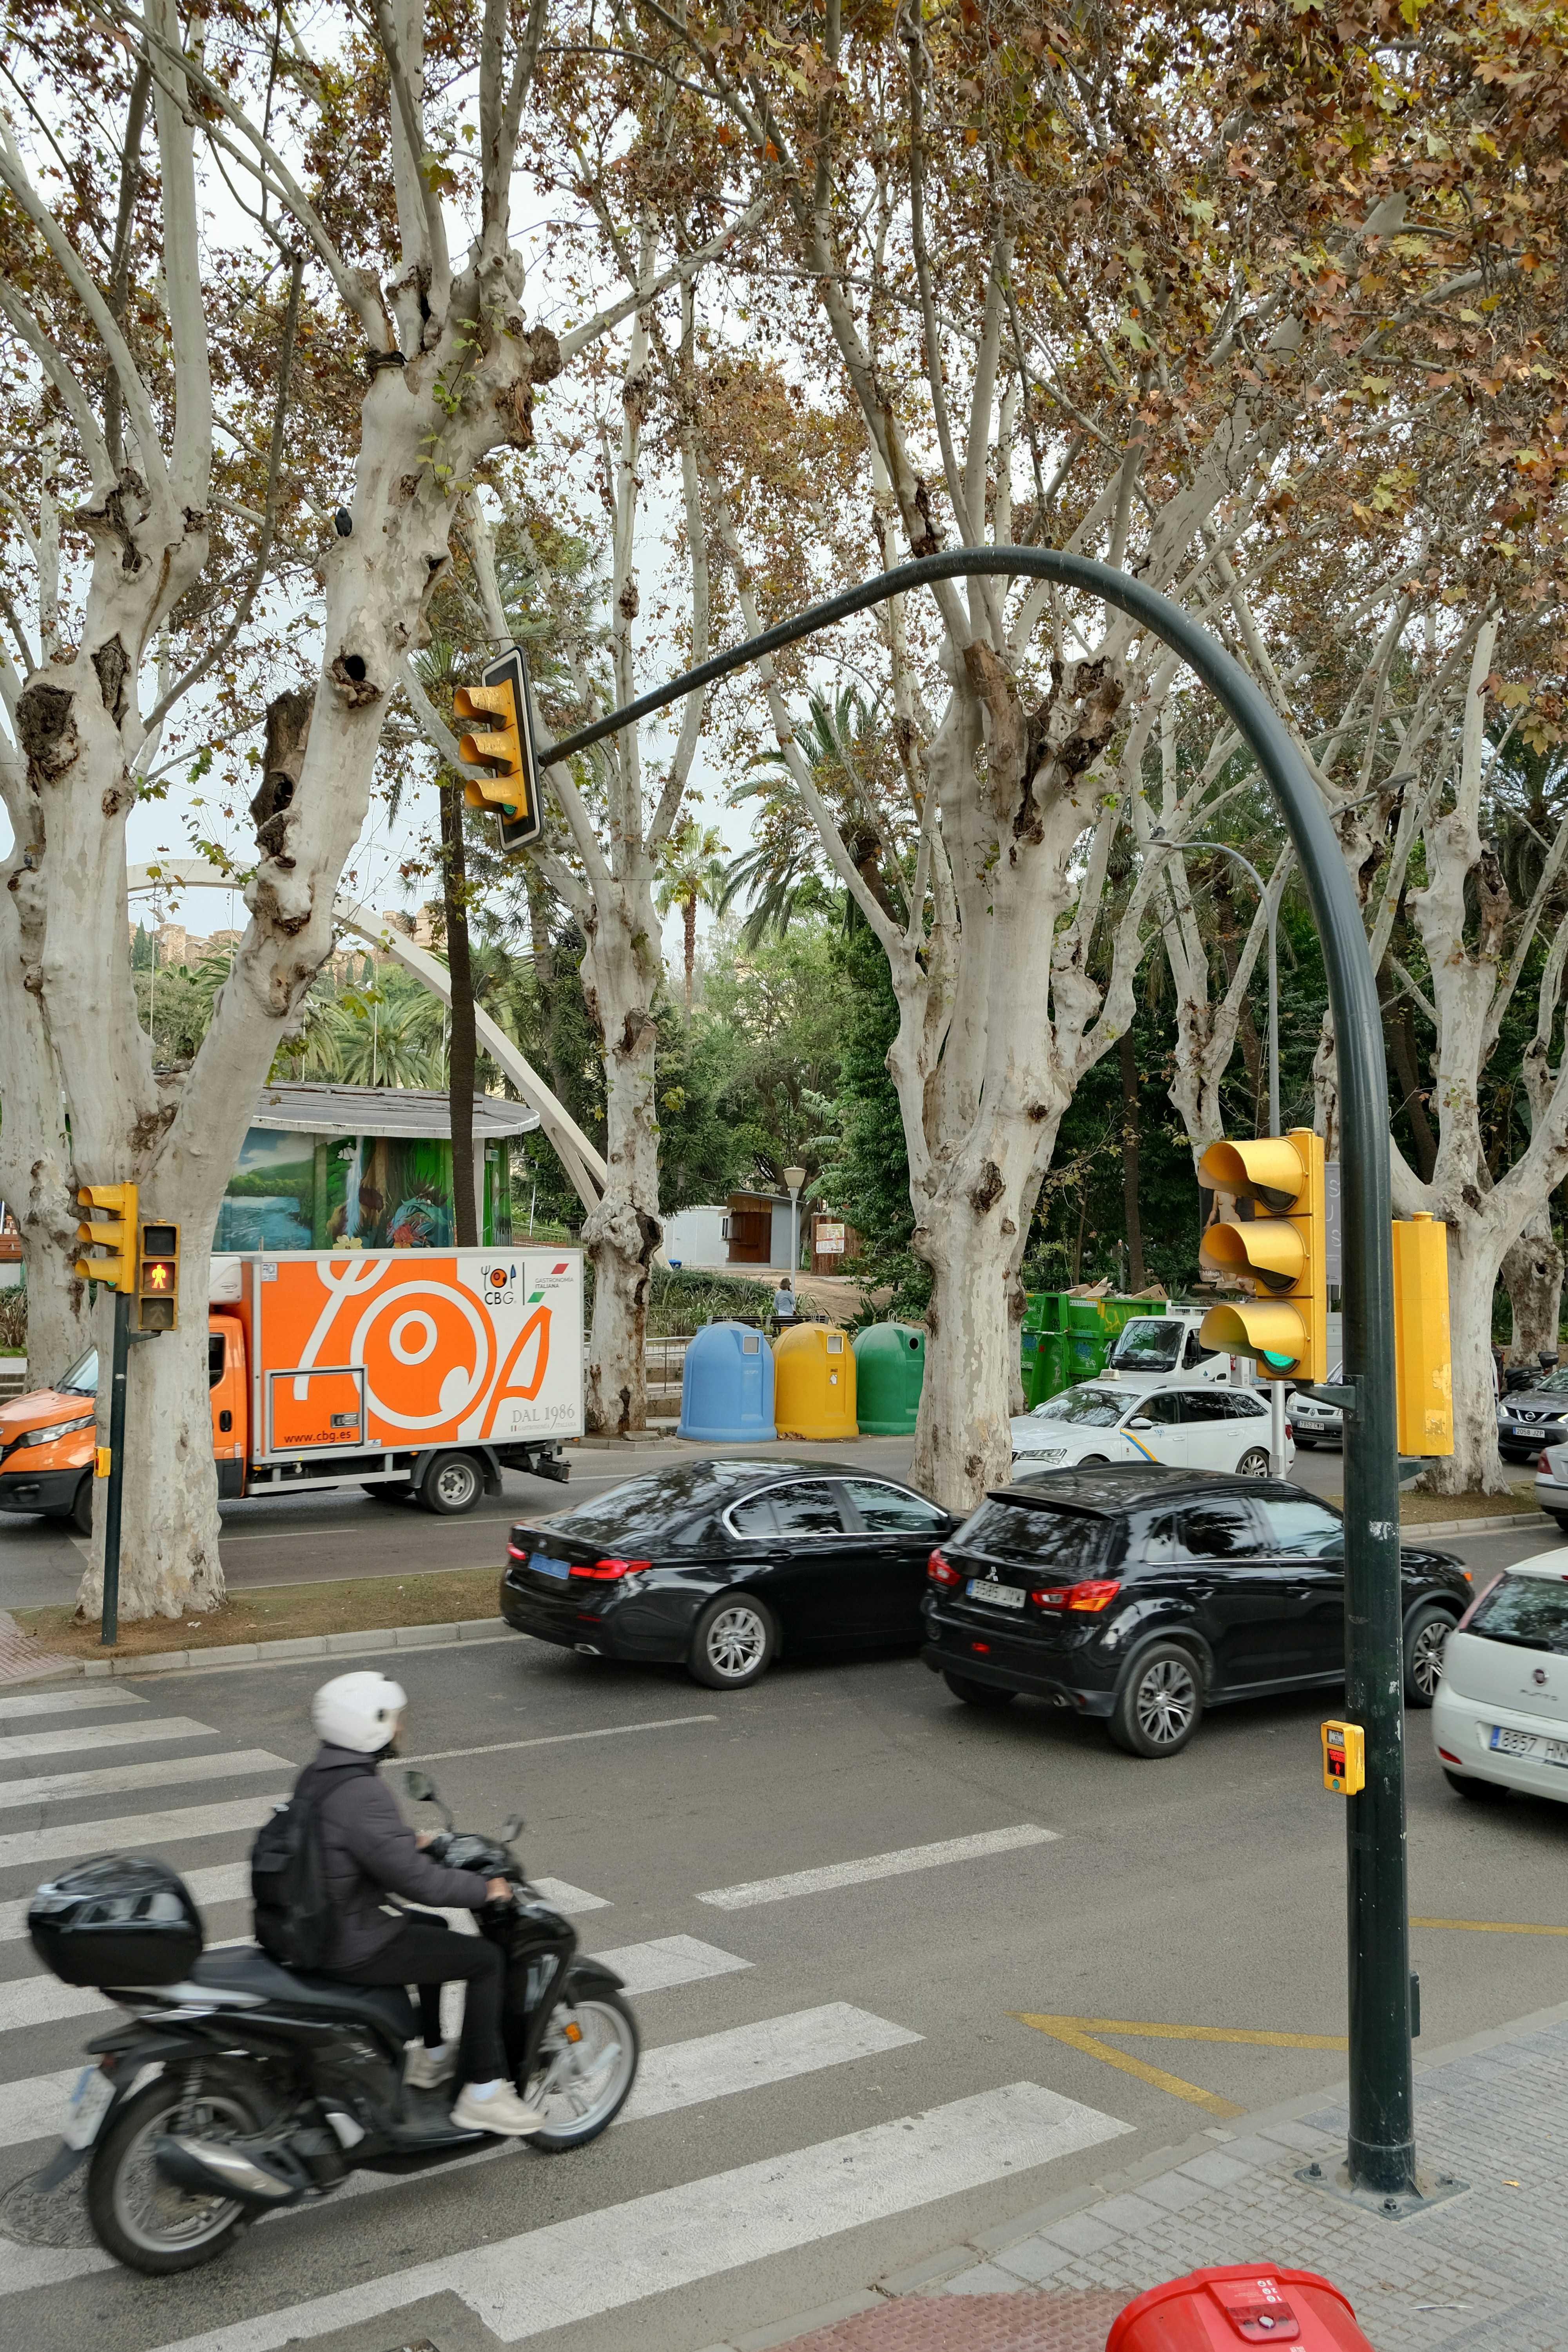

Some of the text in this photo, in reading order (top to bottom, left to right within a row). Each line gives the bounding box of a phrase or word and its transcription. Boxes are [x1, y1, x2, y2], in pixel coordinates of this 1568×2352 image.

[485, 1291, 514, 1305] CBG
[512, 1403, 575, 1431] DAL 1986
[284, 1430, 351, 1443] www.cbg.es
[1501, 1732, 1538, 1753] 8857
